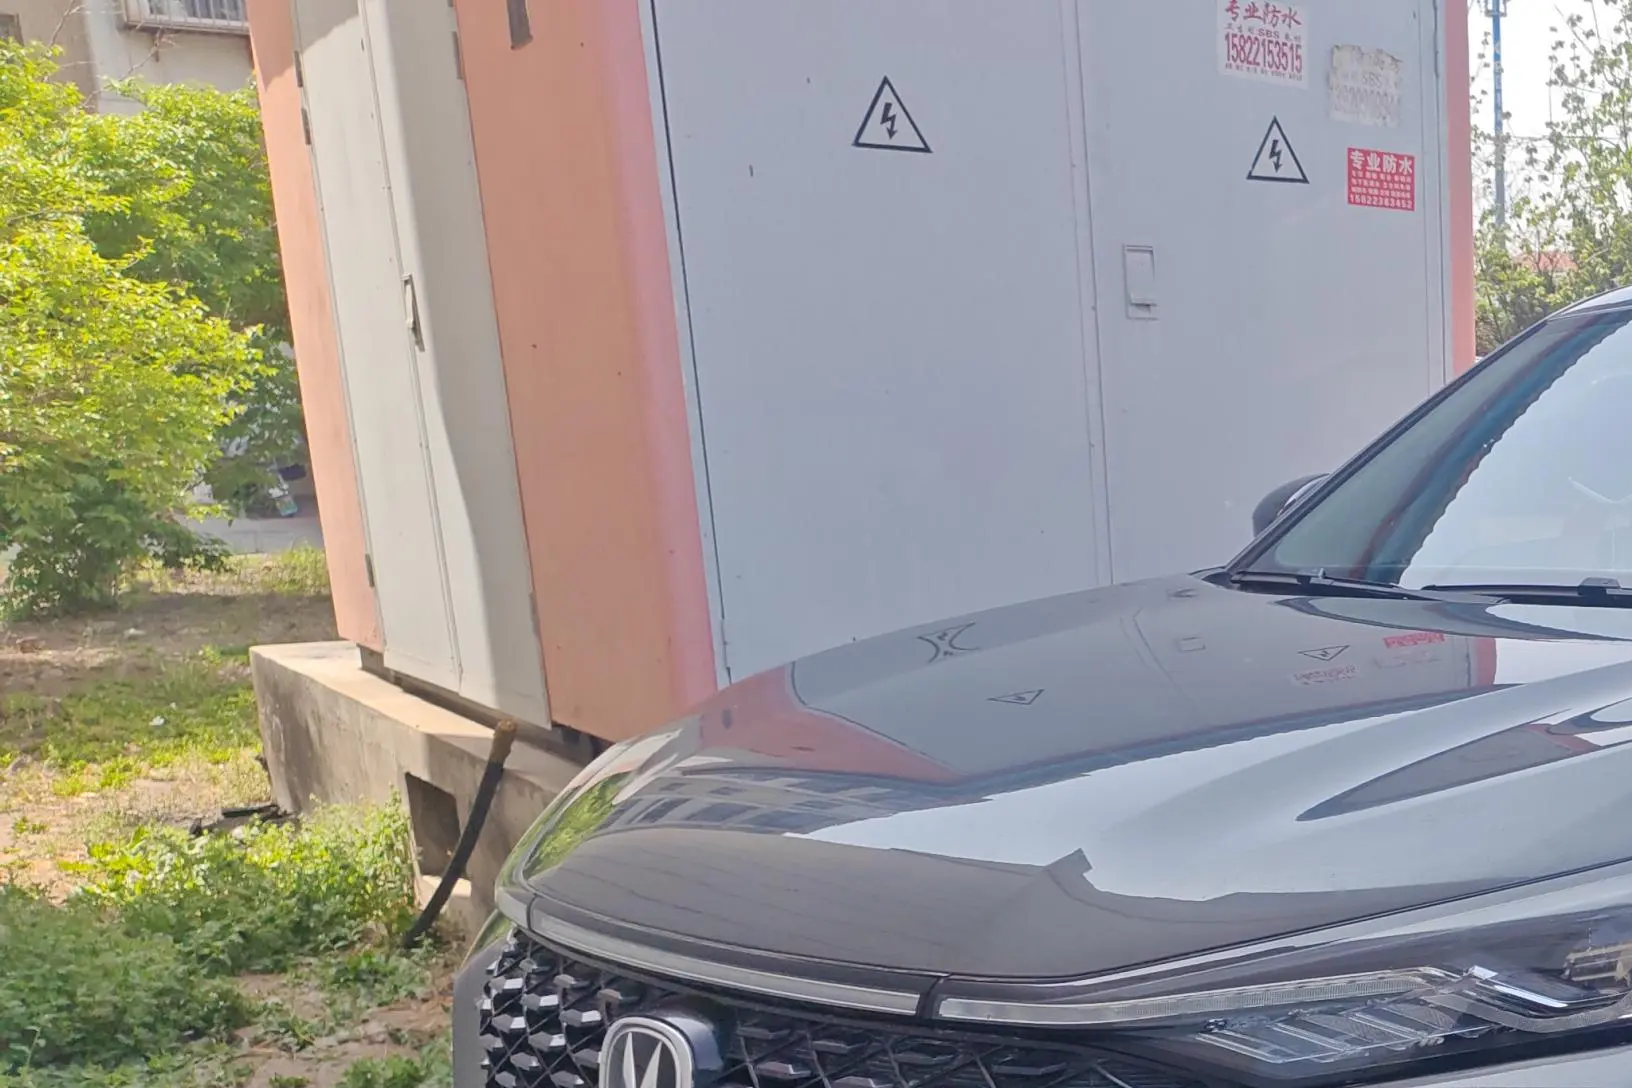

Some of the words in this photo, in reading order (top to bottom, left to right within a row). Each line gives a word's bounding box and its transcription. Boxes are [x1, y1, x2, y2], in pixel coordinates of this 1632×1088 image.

[1225, 0, 1303, 29] 专业防水
[1258, 28, 1280, 39] SBS
[1225, 32, 1302, 74] 15822153515
[1350, 150, 1412, 175] 专业防水
